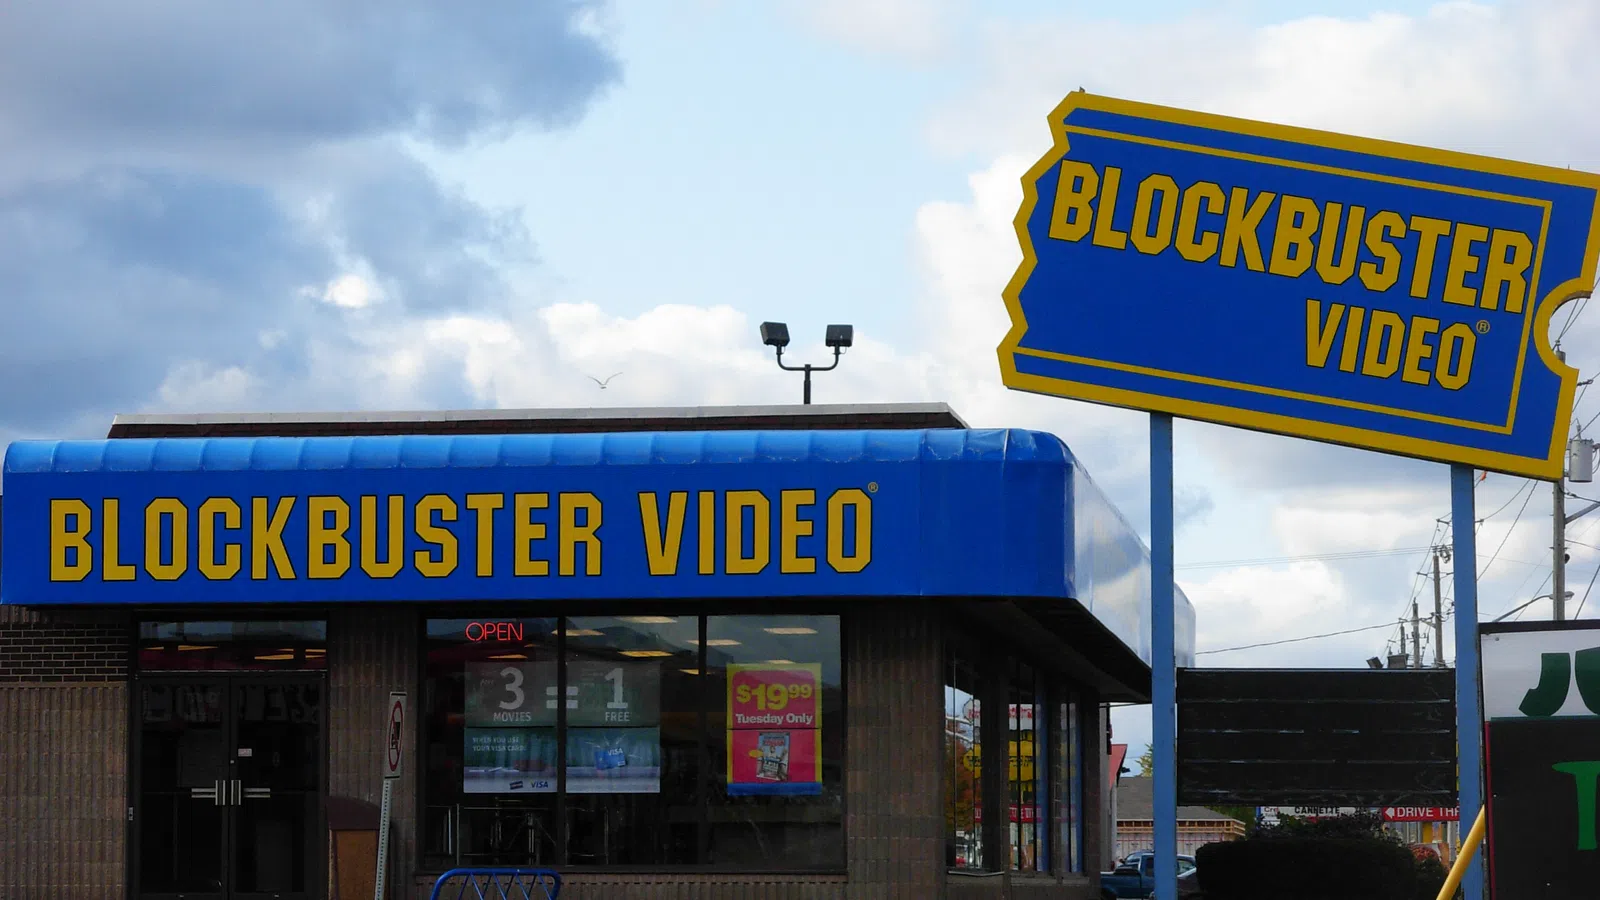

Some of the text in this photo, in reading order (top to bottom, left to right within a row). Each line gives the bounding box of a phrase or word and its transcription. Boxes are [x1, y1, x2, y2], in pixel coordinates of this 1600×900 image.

[1048, 159, 1534, 314] BLOCKBUSTER
[49, 491, 604, 583] BLOCKBUSTER
[465, 621, 523, 641] OPEN
[499, 667, 525, 709] 3
[604, 668, 628, 708] 1
[493, 711, 630, 722] MOVIES FREE
[735, 713, 813, 725] Tuesday Only
[607, 748, 624, 756] VISA
[530, 780, 549, 788] VISA
[1396, 806, 1434, 817] DRIVE
